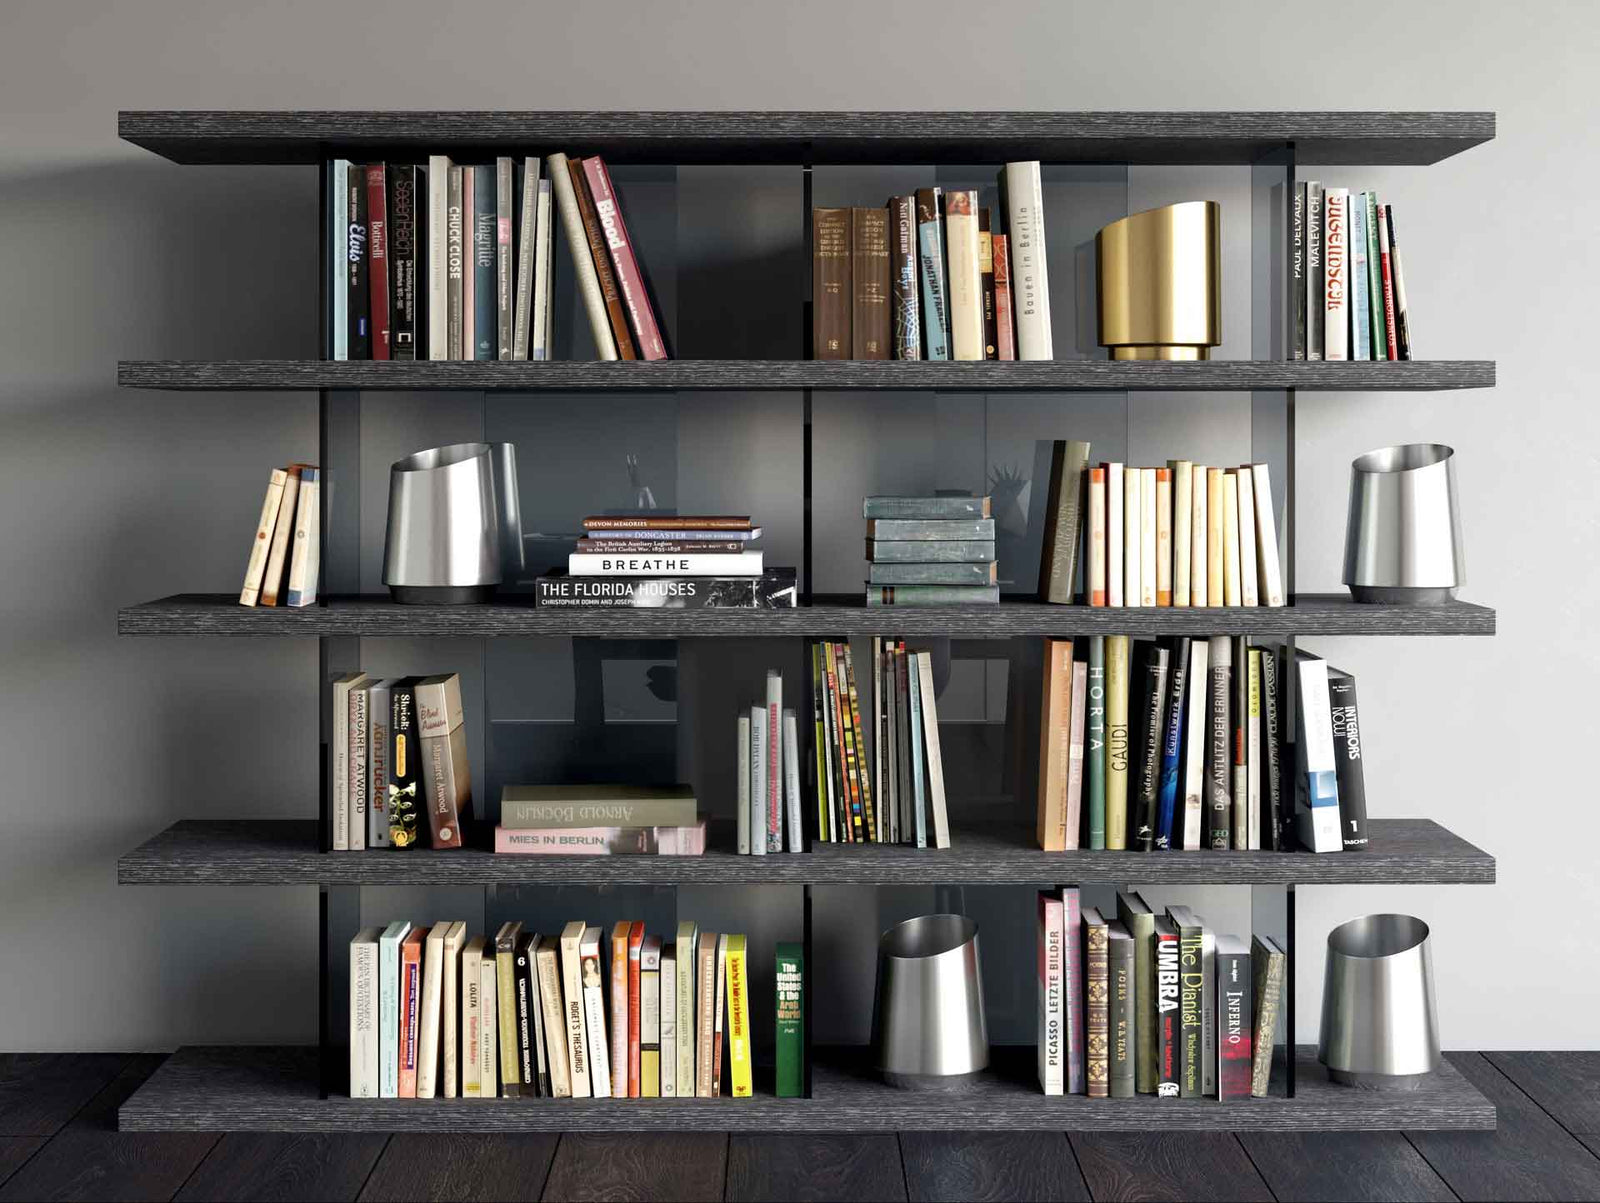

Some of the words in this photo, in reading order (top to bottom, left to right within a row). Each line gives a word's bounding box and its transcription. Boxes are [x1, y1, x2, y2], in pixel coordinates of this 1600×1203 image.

[371, 221, 383, 258] Botticelli
[449, 207, 459, 243] CHUCK
[475, 213, 495, 267] Magritte
[596, 199, 625, 249] Blood
[1018, 207, 1030, 247] Berlin
[1311, 196, 1320, 266] MALEVITCH
[349, 224, 366, 262] Elvis
[1022, 255, 1030, 267] in
[449, 246, 460, 279] CLOSE
[922, 255, 938, 298] JONATHAN
[1024, 276, 1035, 315] Bauen
[602, 560, 690, 570] BREATHE
[542, 583, 569, 596] THE
[574, 583, 633, 596] FLORIDA
[639, 583, 696, 596] HOUSES
[401, 694, 410, 730] Shriek:
[1090, 666, 1103, 750] HORTA
[1151, 692, 1159, 706] The
[356, 694, 364, 758] MARGARET
[1149, 707, 1158, 737] Promise
[1167, 702, 1180, 755] Kunstwerk
[1215, 717, 1225, 739] DER
[1267, 705, 1277, 734] CLAUDE
[1345, 707, 1360, 760] INTERIORS
[1148, 739, 1156, 747] of
[432, 744, 444, 781] Margaret
[1144, 748, 1155, 796] Photography
[1215, 741, 1225, 785] ANTLITZ
[356, 764, 364, 813] ATWOOD
[374, 760, 387, 812] rucker
[437, 783, 448, 813] Atwood
[1215, 787, 1224, 810] DAS
[509, 835, 539, 843] MIES
[544, 836, 555, 844] IN
[1350, 820, 1358, 832] 1
[517, 957, 526, 966] 6
[782, 963, 797, 972] The
[1051, 930, 1059, 970] BILDER
[1182, 933, 1202, 966] The
[777, 972, 801, 982] United
[777, 982, 801, 991] States
[786, 991, 799, 1000] the
[1050, 974, 1058, 1013] LETZTE
[1158, 941, 1180, 1013] UMBRA
[570, 1001, 581, 1030] ROGET'S
[1182, 972, 1202, 1029] Pianist
[1227, 991, 1243, 1045] INFERNO
[573, 1033, 583, 1073] THESAURUS
[1049, 1020, 1057, 1066] PICASSO
